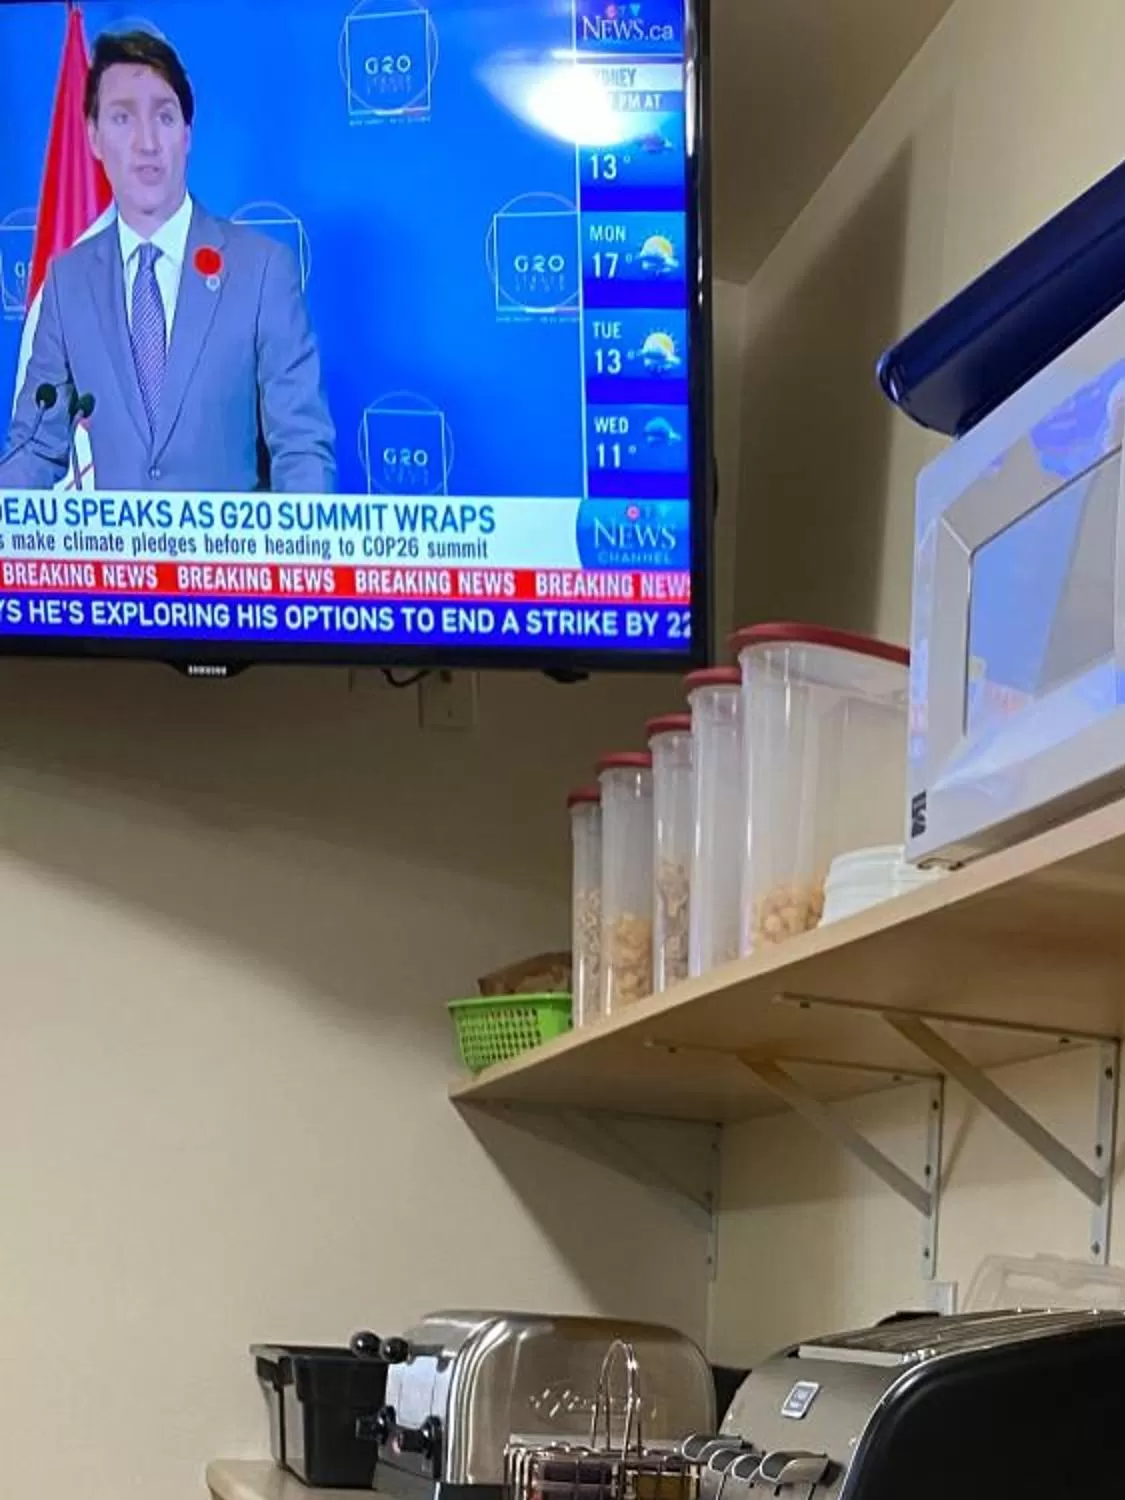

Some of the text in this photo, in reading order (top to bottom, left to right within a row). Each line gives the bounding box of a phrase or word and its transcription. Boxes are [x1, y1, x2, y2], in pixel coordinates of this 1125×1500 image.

[589, 224, 626, 242] MON
[592, 321, 622, 339] TUE
[594, 416, 629, 434] WED
[0, 497, 496, 534] EAU SPEAKS AS G20 SUMMIT WRAPS
[12, 531, 56, 551] make
[63, 531, 125, 552] climate
[132, 532, 197, 557] pledges
[204, 533, 257, 554] before
[265, 534, 331, 560] heading
[339, 536, 355, 556] to
[363, 536, 419, 557] COP26
[427, 537, 489, 559] summit
[593, 517, 677, 550] NEWS
[597, 551, 673, 565] CHANNEL
[3, 562, 691, 598] BREAKING NEWS BREAKING NEWS BREAKING NEWS BREAKING NEW
[29, 600, 85, 626] HE'S
[92, 601, 231, 628] EXPLORING
[237, 603, 278, 630] HIS
[285, 604, 395, 632] OPTIONS
[401, 607, 435, 633] TO
[442, 607, 496, 634] END
[501, 609, 521, 636] A
[526, 609, 619, 637] STRIKE
[626, 611, 659, 638] BY
